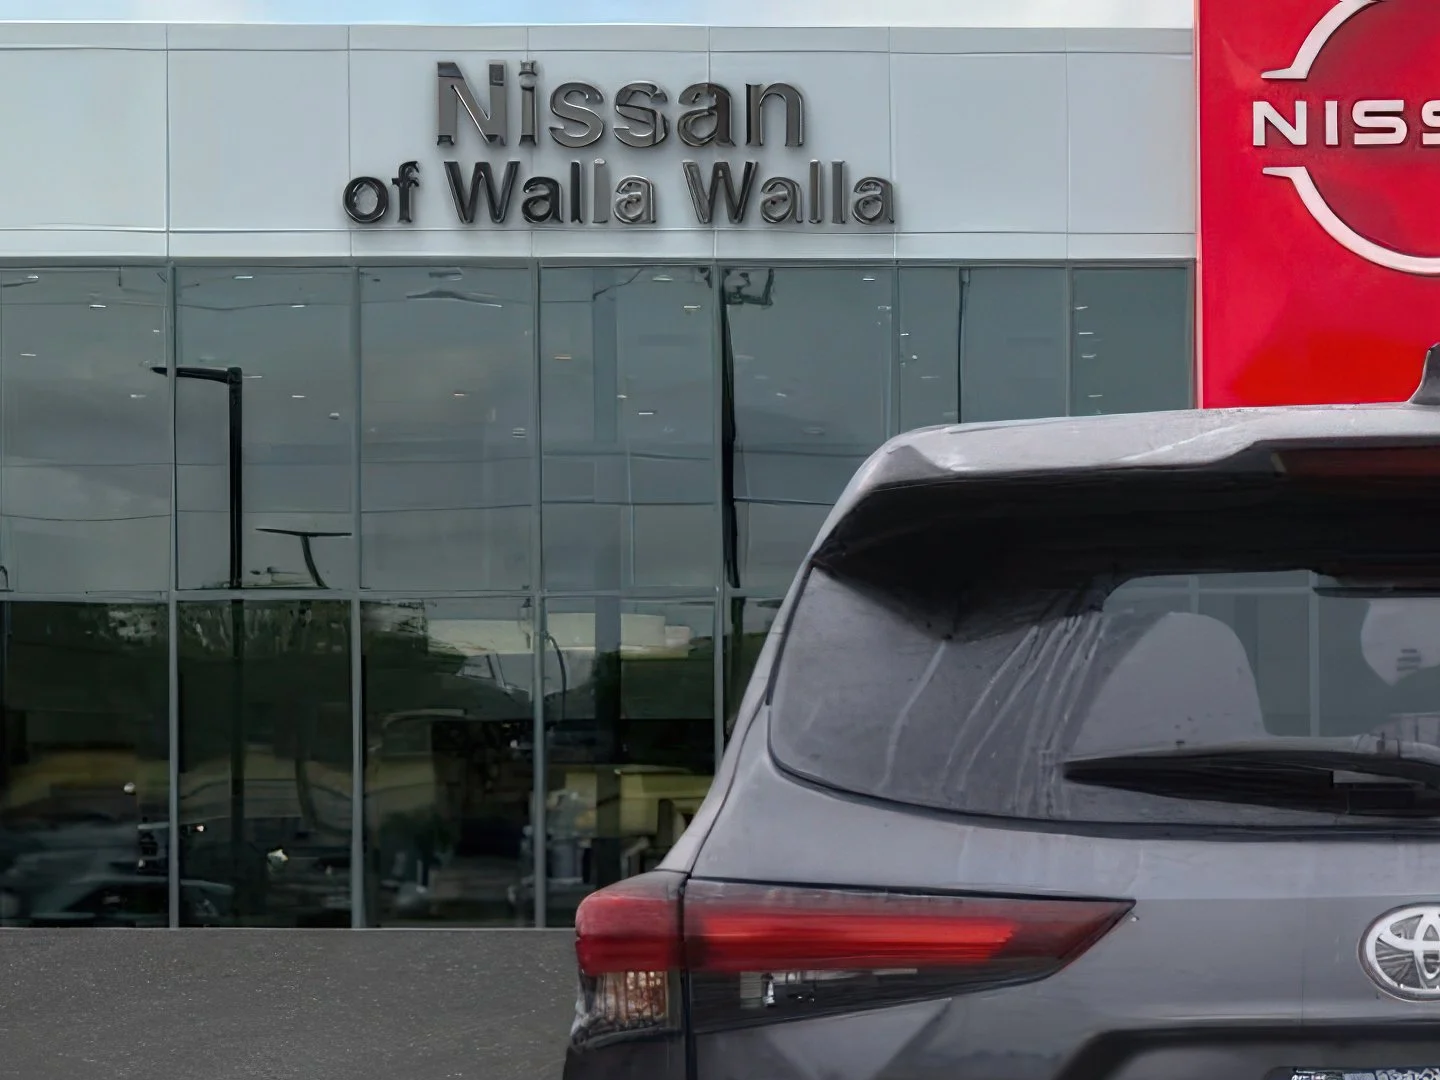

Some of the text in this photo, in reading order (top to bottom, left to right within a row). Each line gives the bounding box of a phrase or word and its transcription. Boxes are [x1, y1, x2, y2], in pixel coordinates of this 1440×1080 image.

[436, 59, 804, 148] Nissan
[342, 159, 896, 225] of Walla Walla
